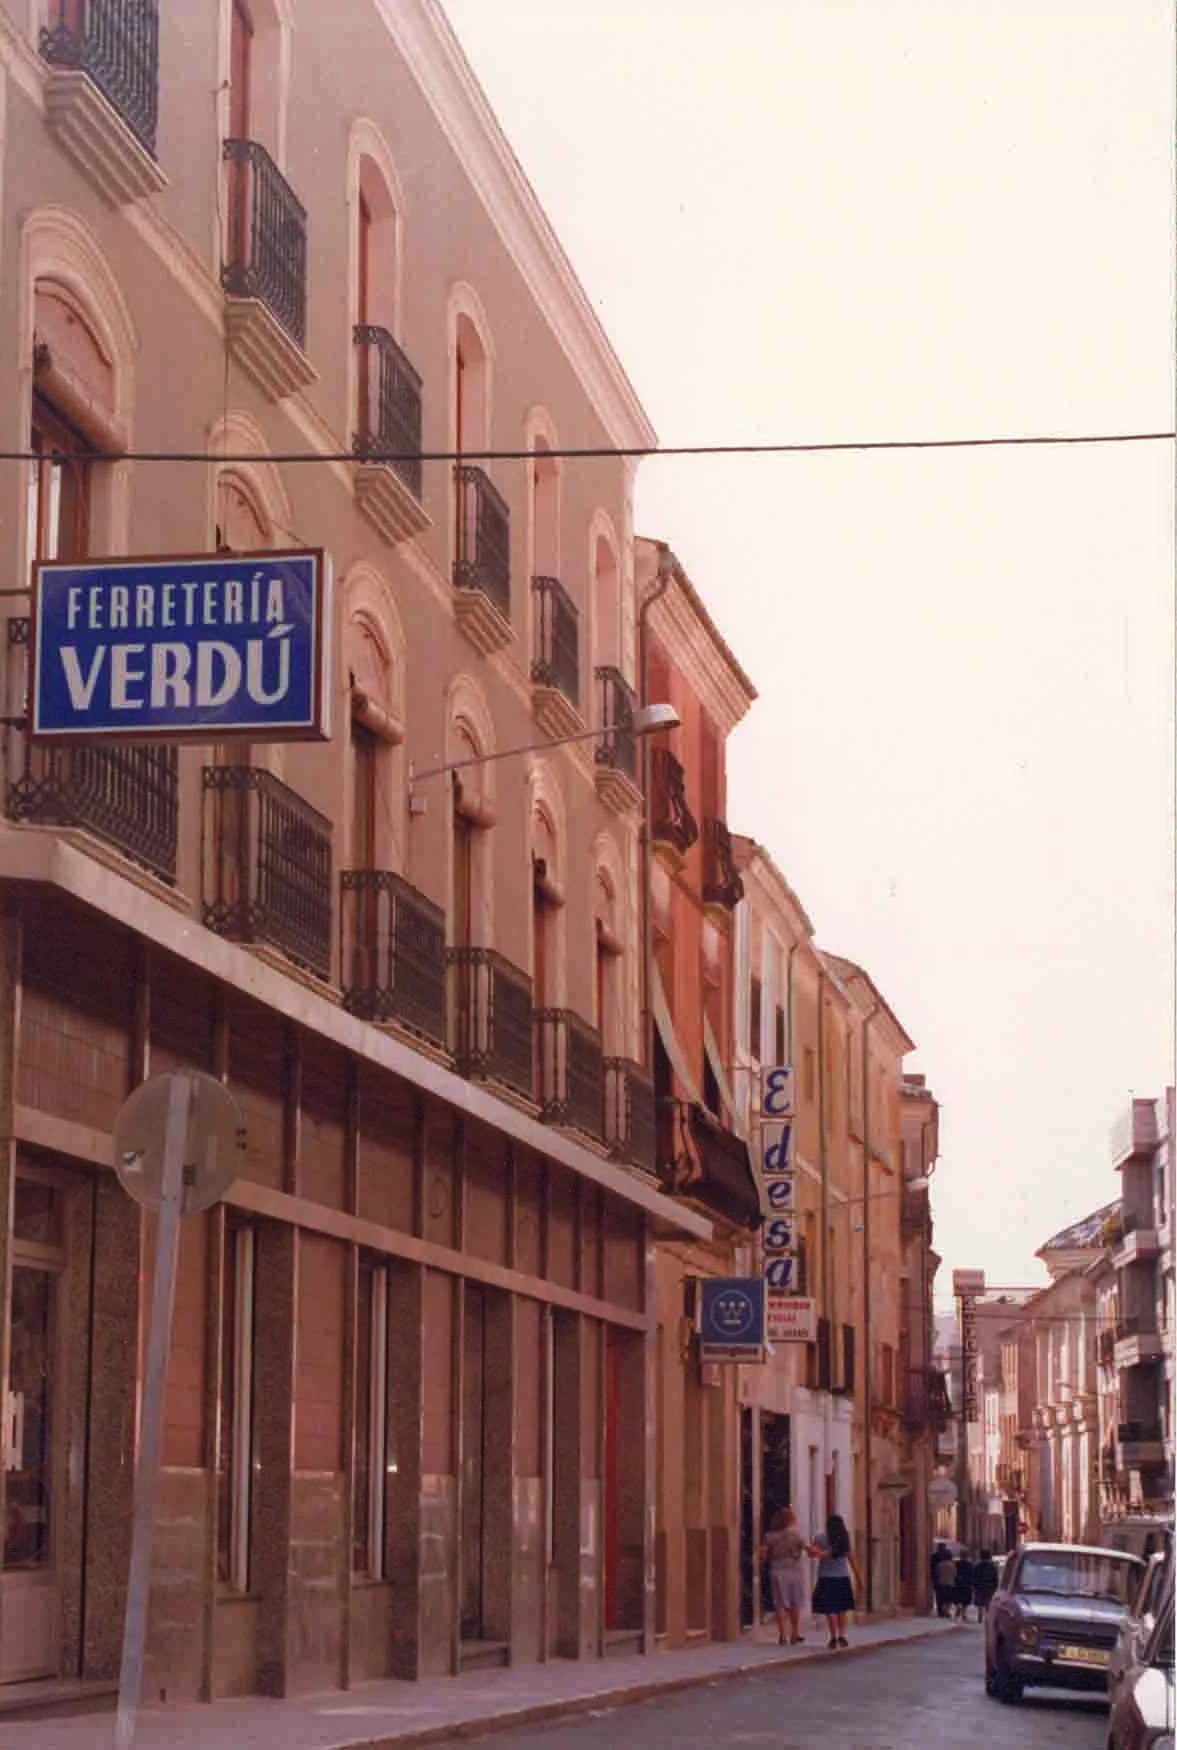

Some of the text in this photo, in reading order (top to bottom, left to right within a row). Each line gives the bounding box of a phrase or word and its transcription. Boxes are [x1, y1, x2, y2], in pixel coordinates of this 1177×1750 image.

[67, 572, 285, 630] FERRETERÍA
[59, 623, 295, 713] VERDÚ
[763, 1070, 792, 1287] Edesa
